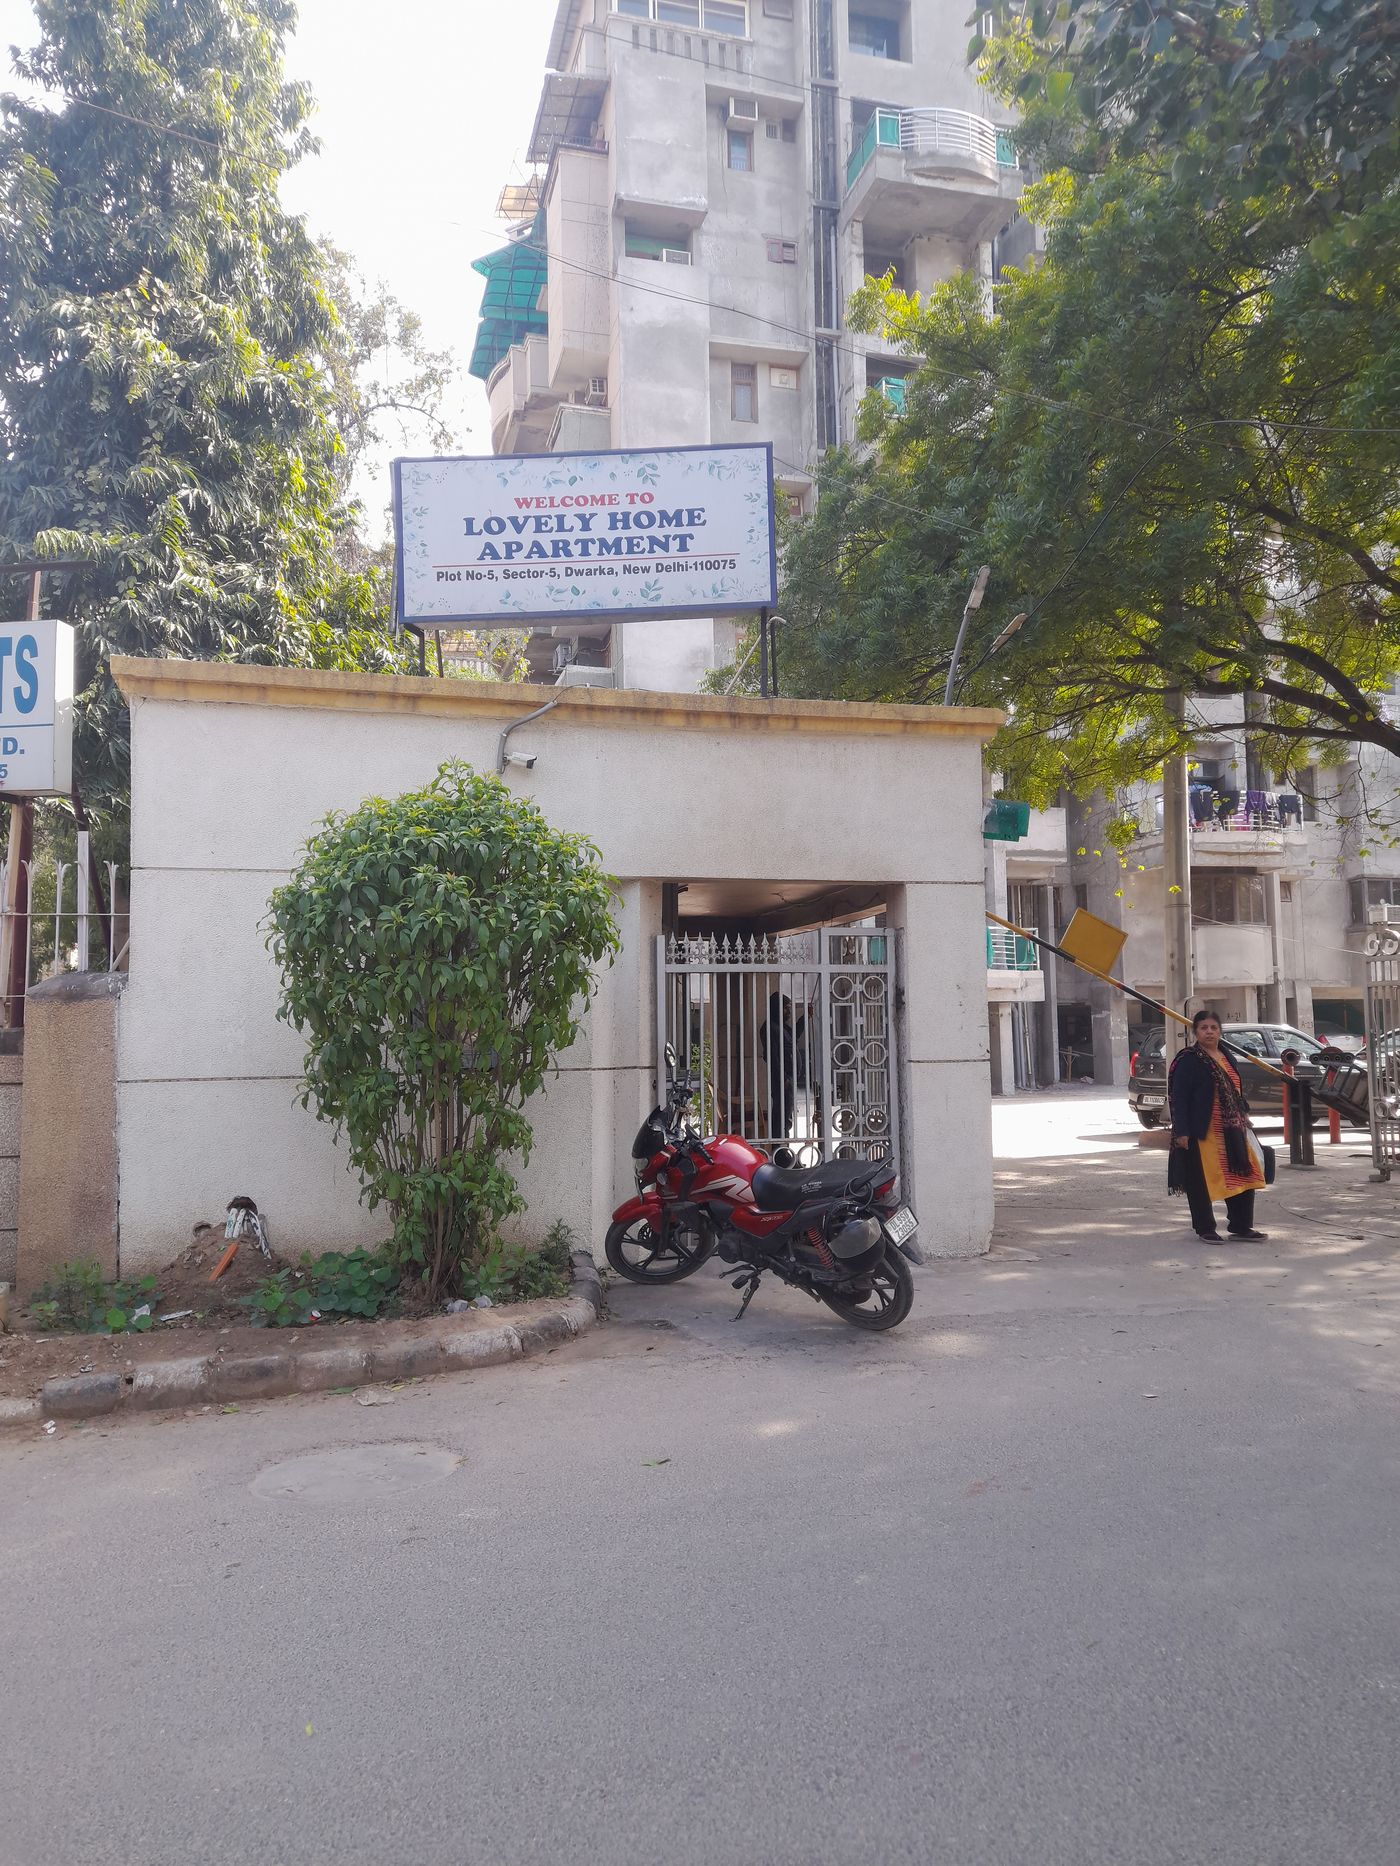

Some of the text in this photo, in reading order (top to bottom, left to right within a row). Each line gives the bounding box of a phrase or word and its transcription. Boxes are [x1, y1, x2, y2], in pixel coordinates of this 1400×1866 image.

[513, 491, 655, 510] WELCOME TO
[463, 507, 707, 536] LOVELY HOME
[476, 533, 695, 561] APARTMENT
[436, 558, 737, 582] Plot No-5, Sector-5, Dwarka, New Delhi-110075
[0, 736, 25, 755] D.
